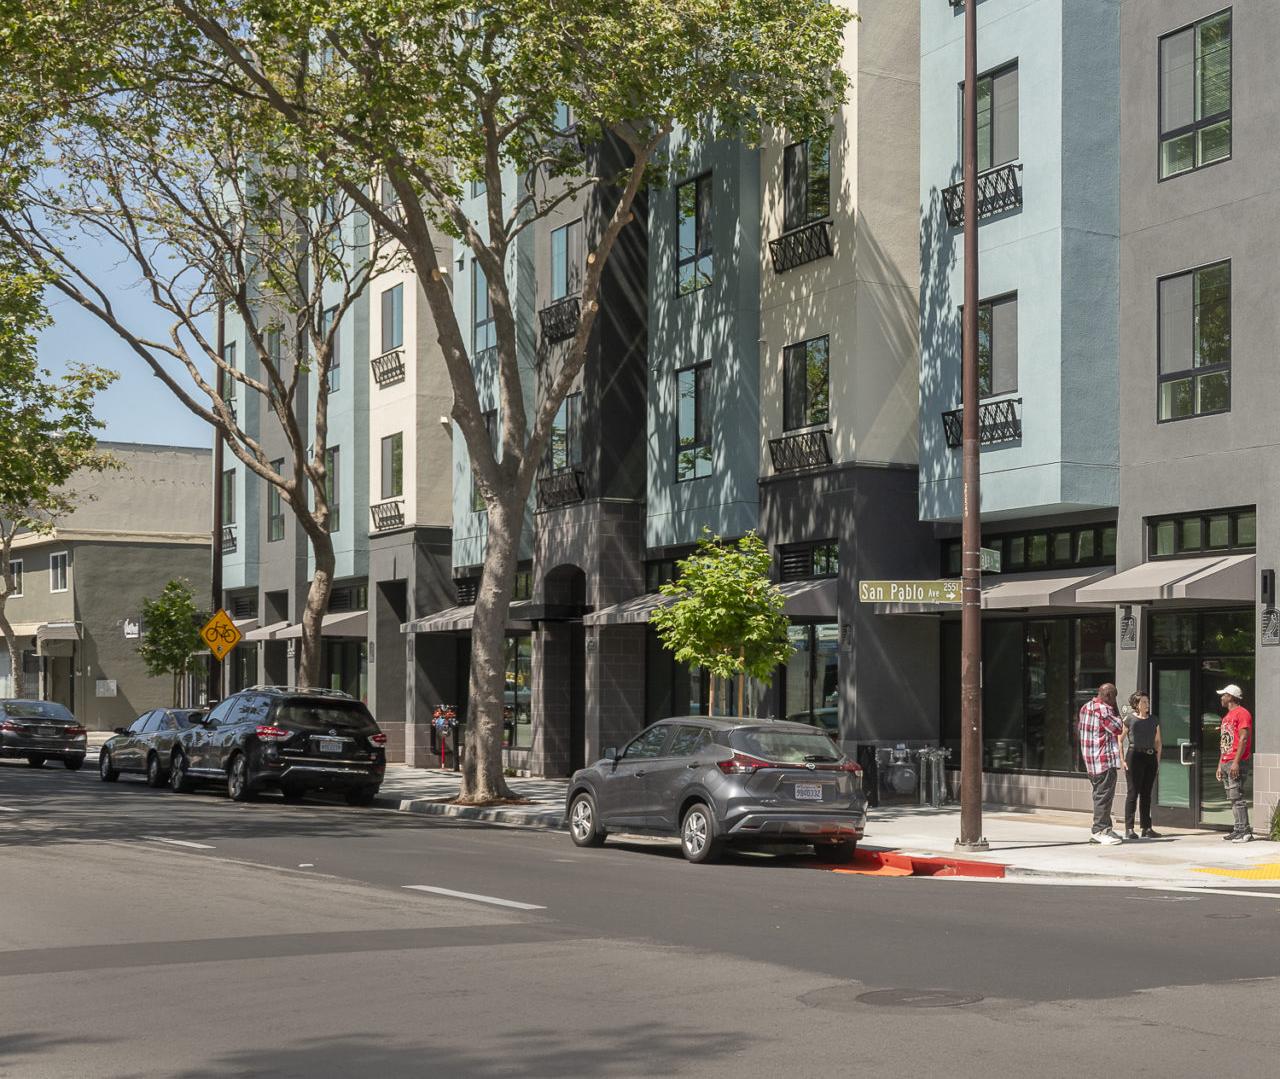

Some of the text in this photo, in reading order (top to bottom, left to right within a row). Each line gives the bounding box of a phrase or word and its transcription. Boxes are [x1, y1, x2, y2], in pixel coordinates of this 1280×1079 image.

[861, 583, 940, 601] San Pablo Ave
[943, 582, 959, 592] 2551
